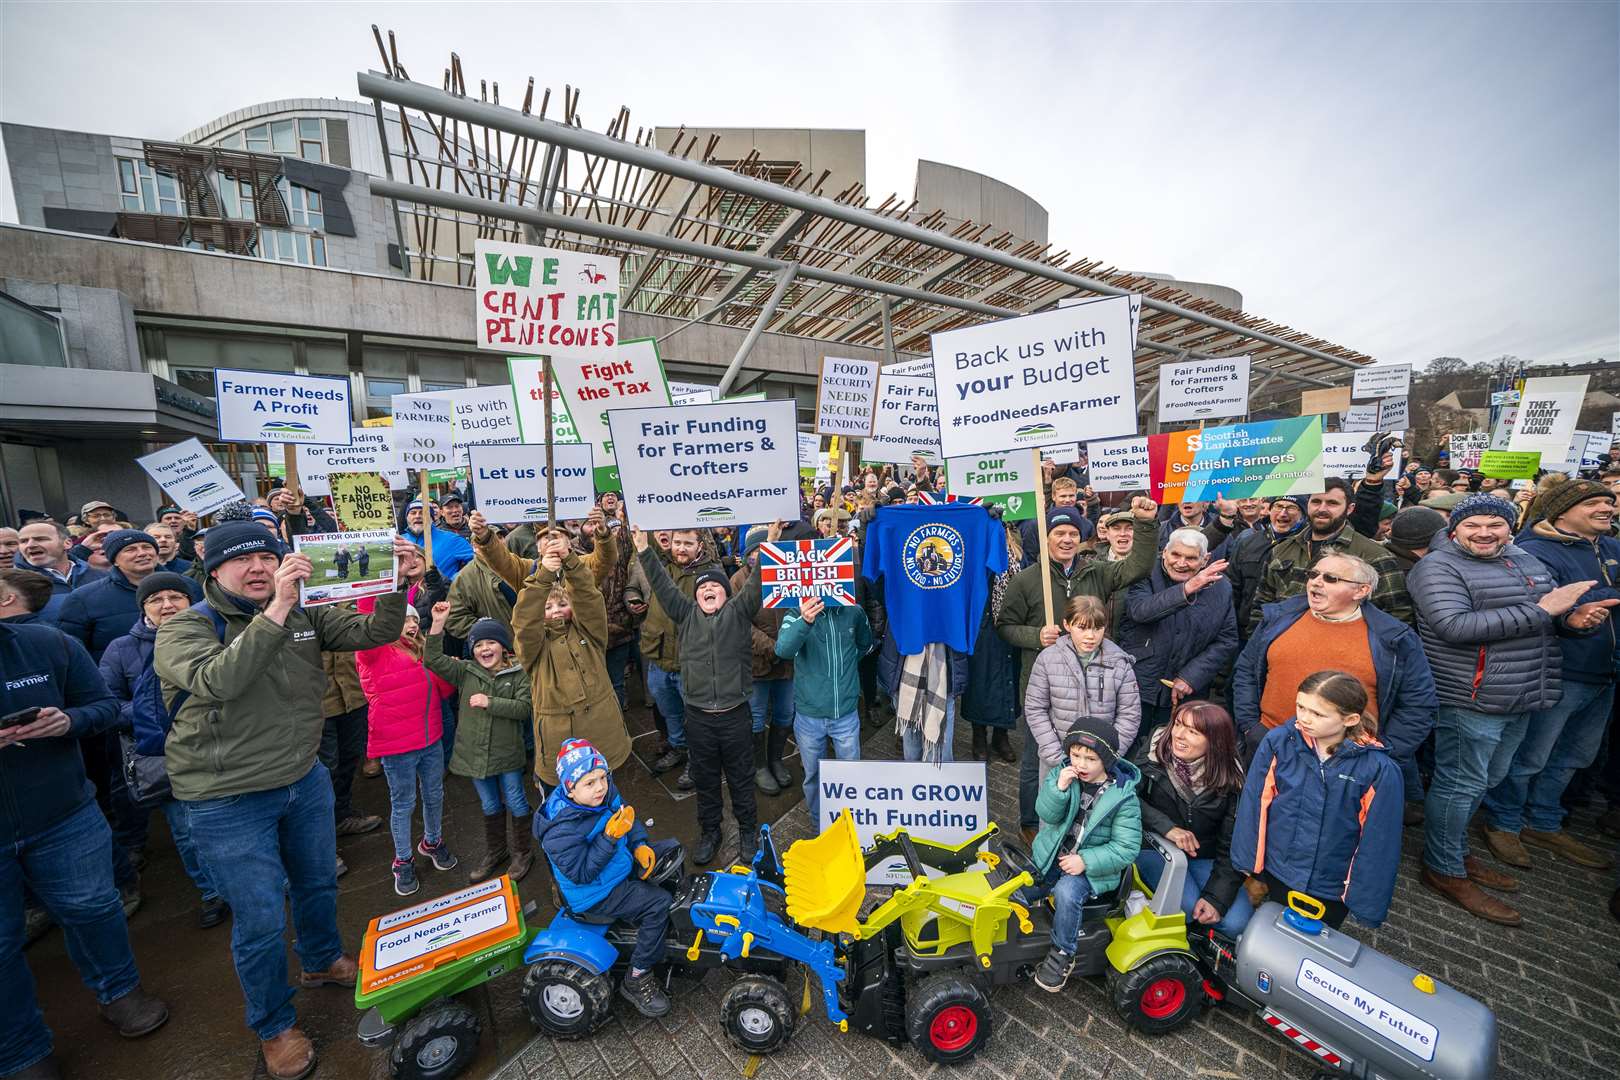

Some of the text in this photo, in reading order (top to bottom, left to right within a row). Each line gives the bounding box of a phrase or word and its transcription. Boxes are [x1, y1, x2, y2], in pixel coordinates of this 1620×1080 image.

[485, 253, 559, 288] WE
[483, 290, 617, 320] CANT EAT
[485, 317, 616, 347] PINECONES
[955, 327, 1106, 370] Back us with
[580, 359, 634, 381] Fight
[833, 363, 868, 376] FOOD
[1174, 364, 1236, 376] Fair Funding
[823, 377, 873, 389] SECURITY
[956, 356, 1110, 401] your Budget
[1170, 378, 1185, 386] for
[1187, 375, 1228, 385] Farmers
[222, 381, 344, 401] Farmer Needs
[577, 380, 652, 401] the Tax
[827, 390, 868, 403] NEEDS
[888, 385, 936, 397] Fair Fu
[1184, 385, 1224, 395] Crofters
[253, 400, 319, 415] A Profit
[413, 401, 432, 411] NO
[456, 400, 508, 414] us with
[881, 399, 901, 410] for
[1165, 397, 1243, 409] #FoodNeedsAFarmer
[1528, 400, 1556, 409] THEY
[821, 404, 871, 418] SECURE
[953, 394, 1121, 428] #FoodNeedsAFarmer
[1526, 409, 1561, 418] WANT
[395, 412, 450, 424] FARMERS
[461, 415, 512, 430] Budget
[820, 418, 870, 430] FUNDING
[900, 415, 940, 427] Crofte
[1524, 418, 1554, 426] YOUR
[641, 417, 767, 437] Fair Funding
[1520, 426, 1552, 435] LAND.
[872, 434, 941, 446] #FoodNeedsA
[1204, 429, 1249, 442] Scottish
[412, 437, 435, 449] NO
[637, 437, 775, 458] for Farmers &
[1451, 442, 1465, 450] THE
[307, 444, 390, 456] for Farmers &
[1103, 447, 1128, 456] Less
[155, 453, 202, 473] Your Food.
[327, 456, 375, 466] Crofters
[403, 452, 446, 464] FOOD
[978, 458, 1006, 470] our
[1091, 457, 1149, 469] More Back
[1172, 453, 1296, 473] Scottish Farmers
[1459, 458, 1480, 468] YOU
[174, 464, 195, 474] Your
[480, 467, 509, 480] Let
[514, 469, 535, 479] us
[669, 461, 749, 477] Crofters
[162, 464, 218, 488] Environment.
[966, 470, 1019, 486] Farms
[1157, 470, 1312, 489] Delivering for people, jobs and nature
[354, 485, 370, 494] NO
[637, 486, 788, 504] #FoodNeedsAFarmer
[341, 493, 387, 503] FARMER
[485, 495, 587, 506] #FoodNeedsarmer
[356, 502, 372, 511] NO
[352, 509, 382, 520] FOOD
[300, 535, 325, 544] FIGHT
[909, 527, 960, 549] NO FARMERS
[223, 540, 266, 555] BOORTMALT
[785, 549, 827, 564] BACK
[906, 557, 915, 569] NO
[776, 565, 838, 581] BRITISH
[933, 577, 943, 586] NO
[772, 583, 844, 599] FARMING
[5, 674, 49, 691] Farmer
[822, 782, 983, 802] We can GROW
[887, 809, 977, 831] Funding
[380, 935, 410, 951] Food
[414, 923, 450, 940] Needs
[464, 904, 502, 921] Farmer
[369, 964, 425, 989] AMAZONE
[1304, 969, 1430, 1046] Secure My Future
